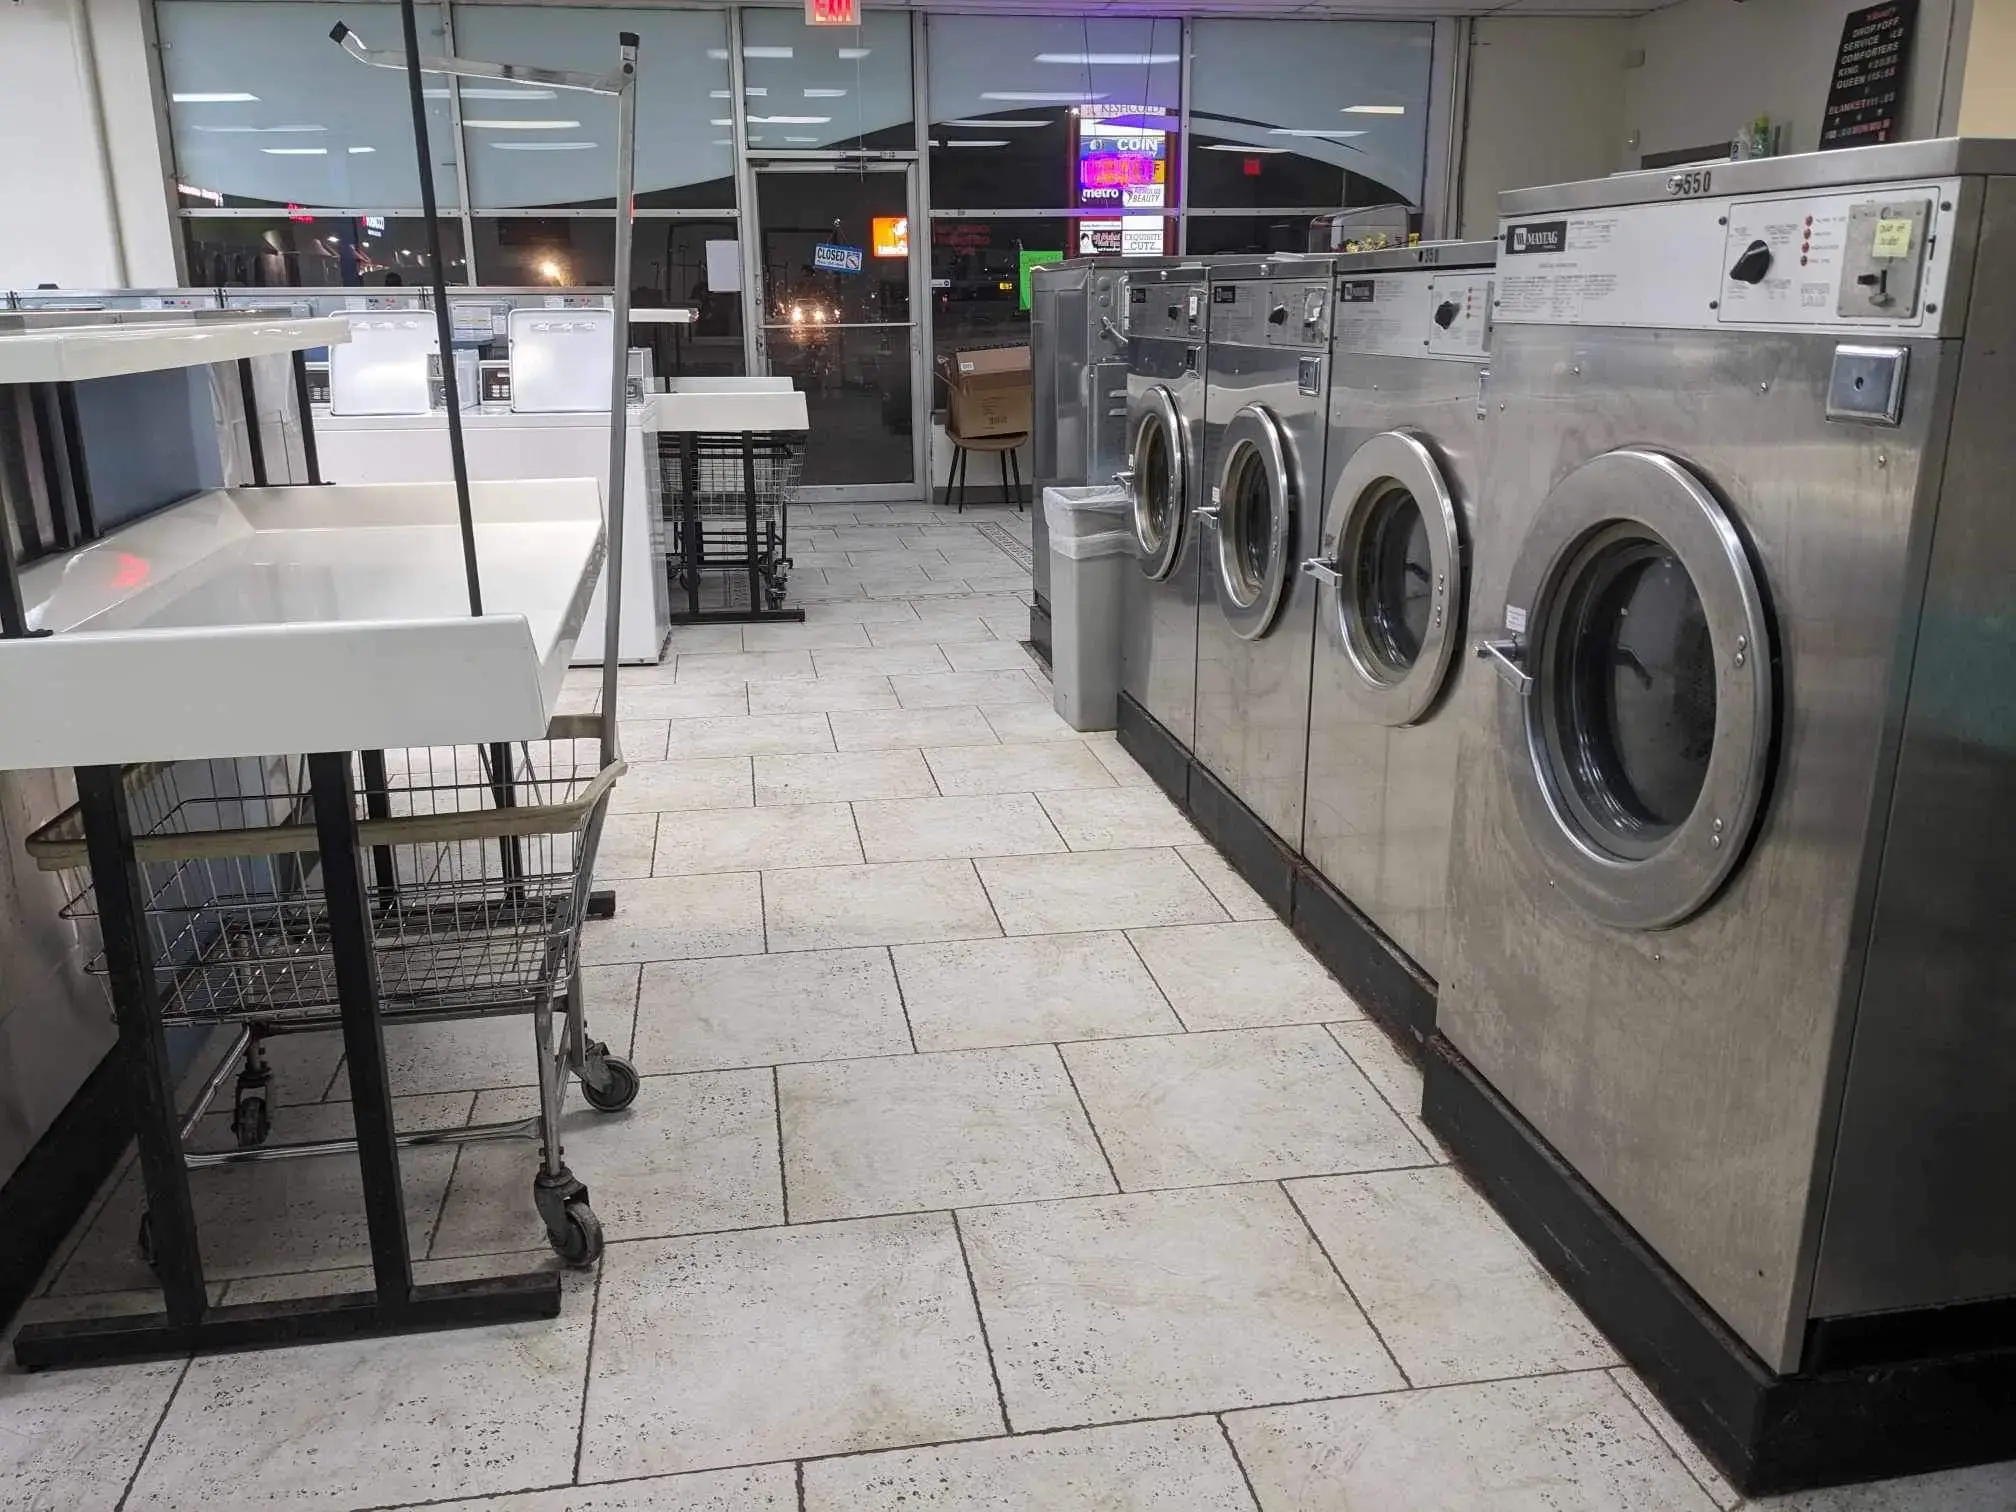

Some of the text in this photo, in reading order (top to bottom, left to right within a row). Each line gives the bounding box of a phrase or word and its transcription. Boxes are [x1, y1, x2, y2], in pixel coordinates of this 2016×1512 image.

[814, 0, 852, 22] EXIT
[1843, 34, 1880, 52] SERVICE
[1841, 41, 1899, 64] COMFORTERS
[1838, 65, 1859, 77] KING
[1836, 75, 1865, 89] QUEEN
[1117, 138, 1158, 151] COIN
[1082, 188, 1119, 199] metro
[1527, 230, 1559, 246] MAYTAG
[817, 247, 845, 262] CLOSED
